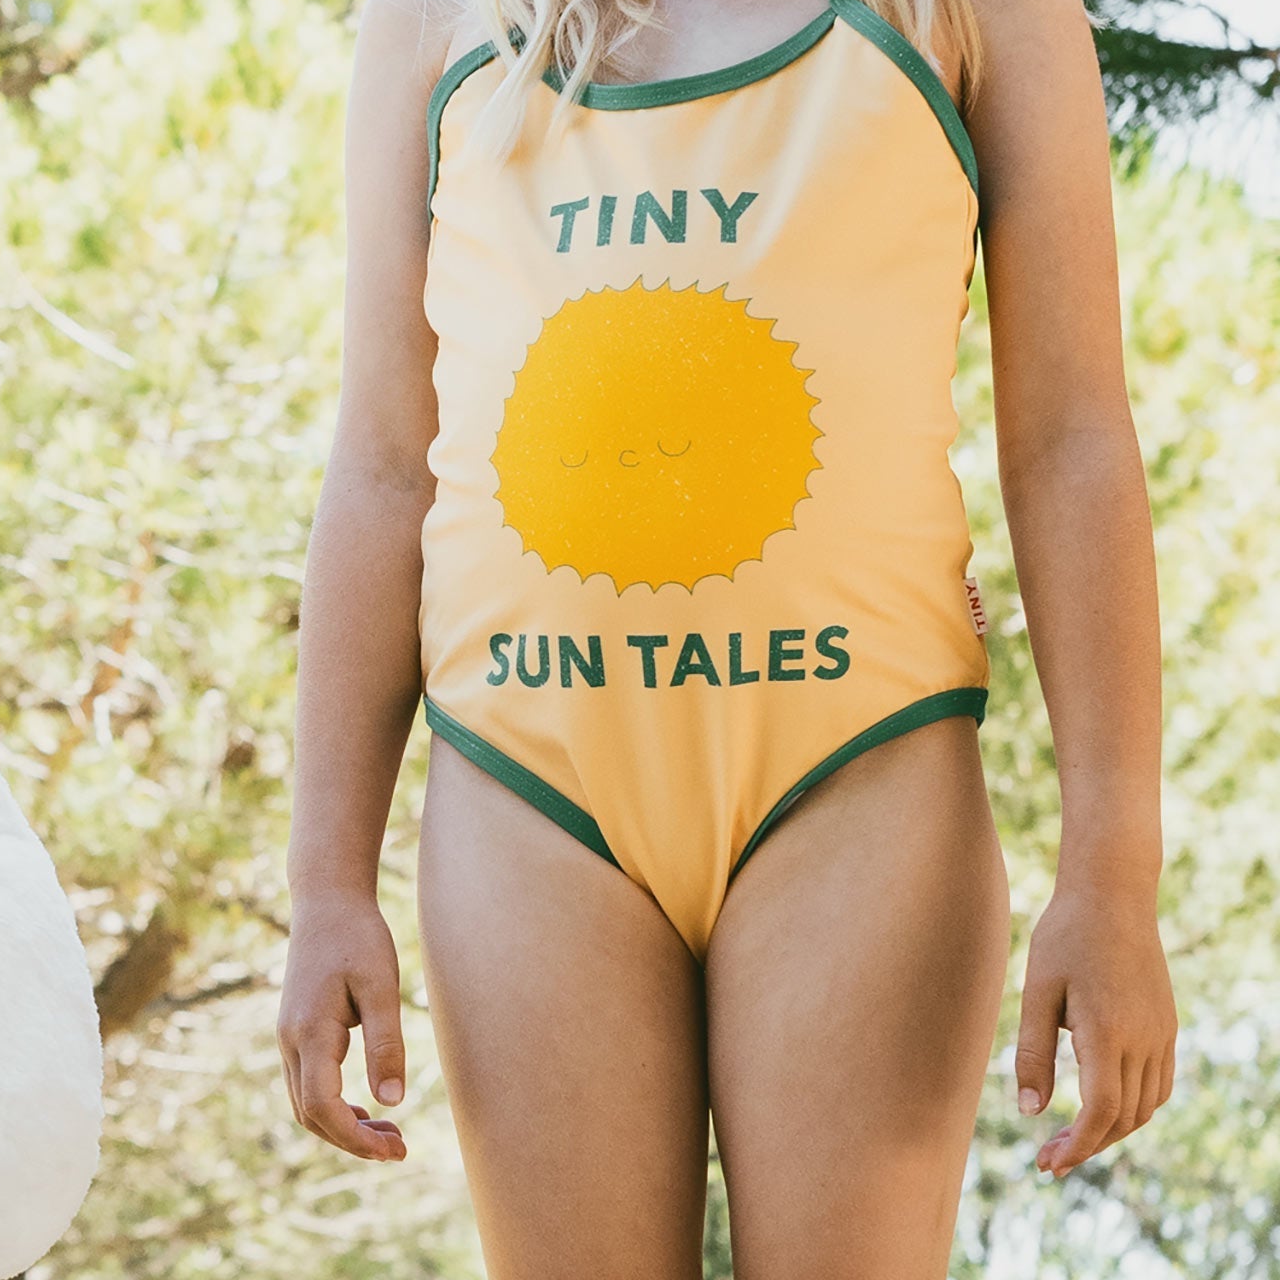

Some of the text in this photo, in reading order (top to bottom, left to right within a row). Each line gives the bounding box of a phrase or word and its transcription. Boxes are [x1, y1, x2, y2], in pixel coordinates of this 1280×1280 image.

[549, 188, 759, 254] TINY
[965, 584, 986, 630] TINY
[485, 625, 851, 689] SUN TALES
